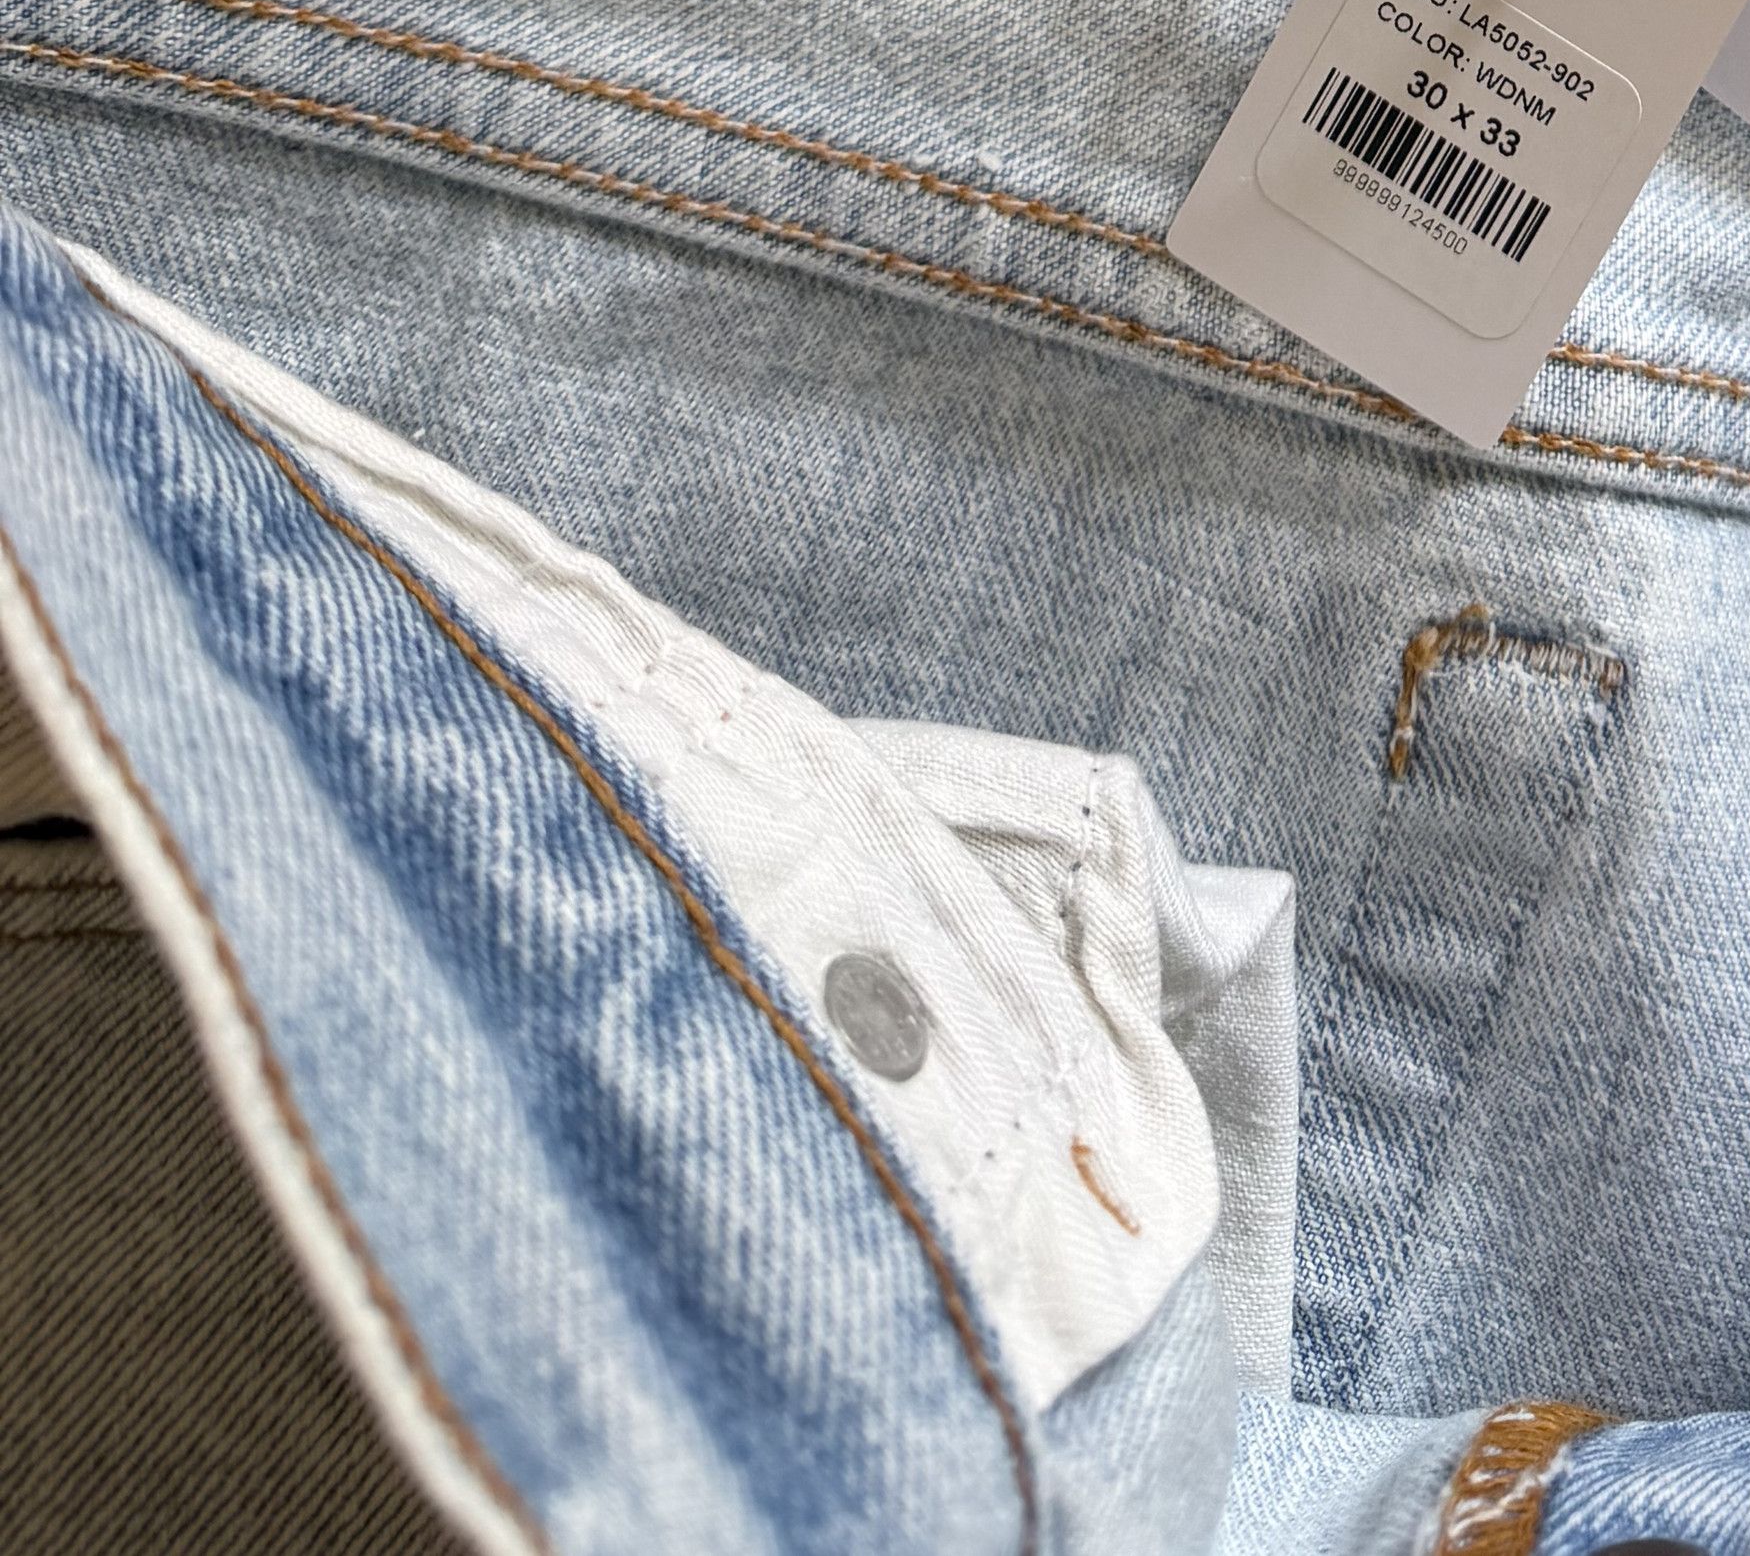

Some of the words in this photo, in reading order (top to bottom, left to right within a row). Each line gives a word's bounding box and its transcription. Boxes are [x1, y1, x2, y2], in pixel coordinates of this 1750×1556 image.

[1377, 0, 1471, 73] COLOR:
[1475, 60, 1557, 126] WDNM
[1458, 2, 1596, 102] LA5052-902
[1406, 69, 1449, 111] 30
[1479, 116, 1521, 158] 33
